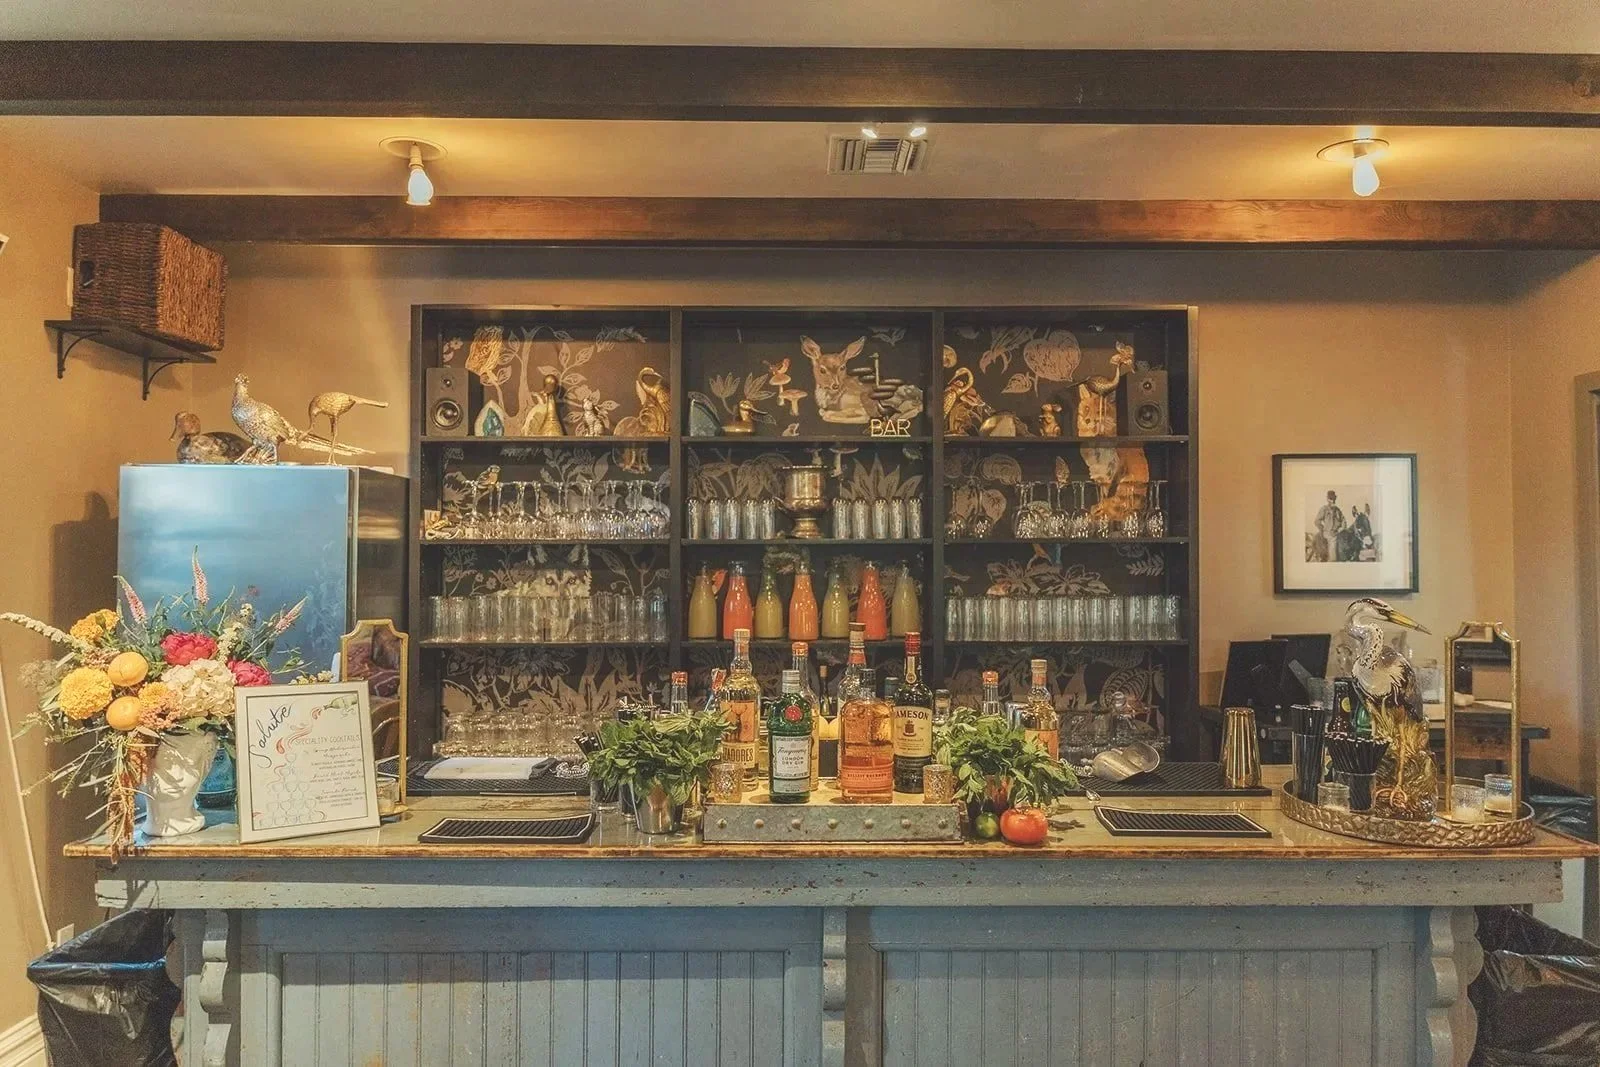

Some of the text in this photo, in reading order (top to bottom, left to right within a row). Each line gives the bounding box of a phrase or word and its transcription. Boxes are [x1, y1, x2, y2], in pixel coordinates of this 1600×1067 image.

[871, 419, 911, 437] BAR
[895, 710, 929, 720] AMESON
[249, 702, 294, 768] Salute
[330, 734, 360, 743] COCKTAILS
[723, 747, 754, 762] ZADORES
